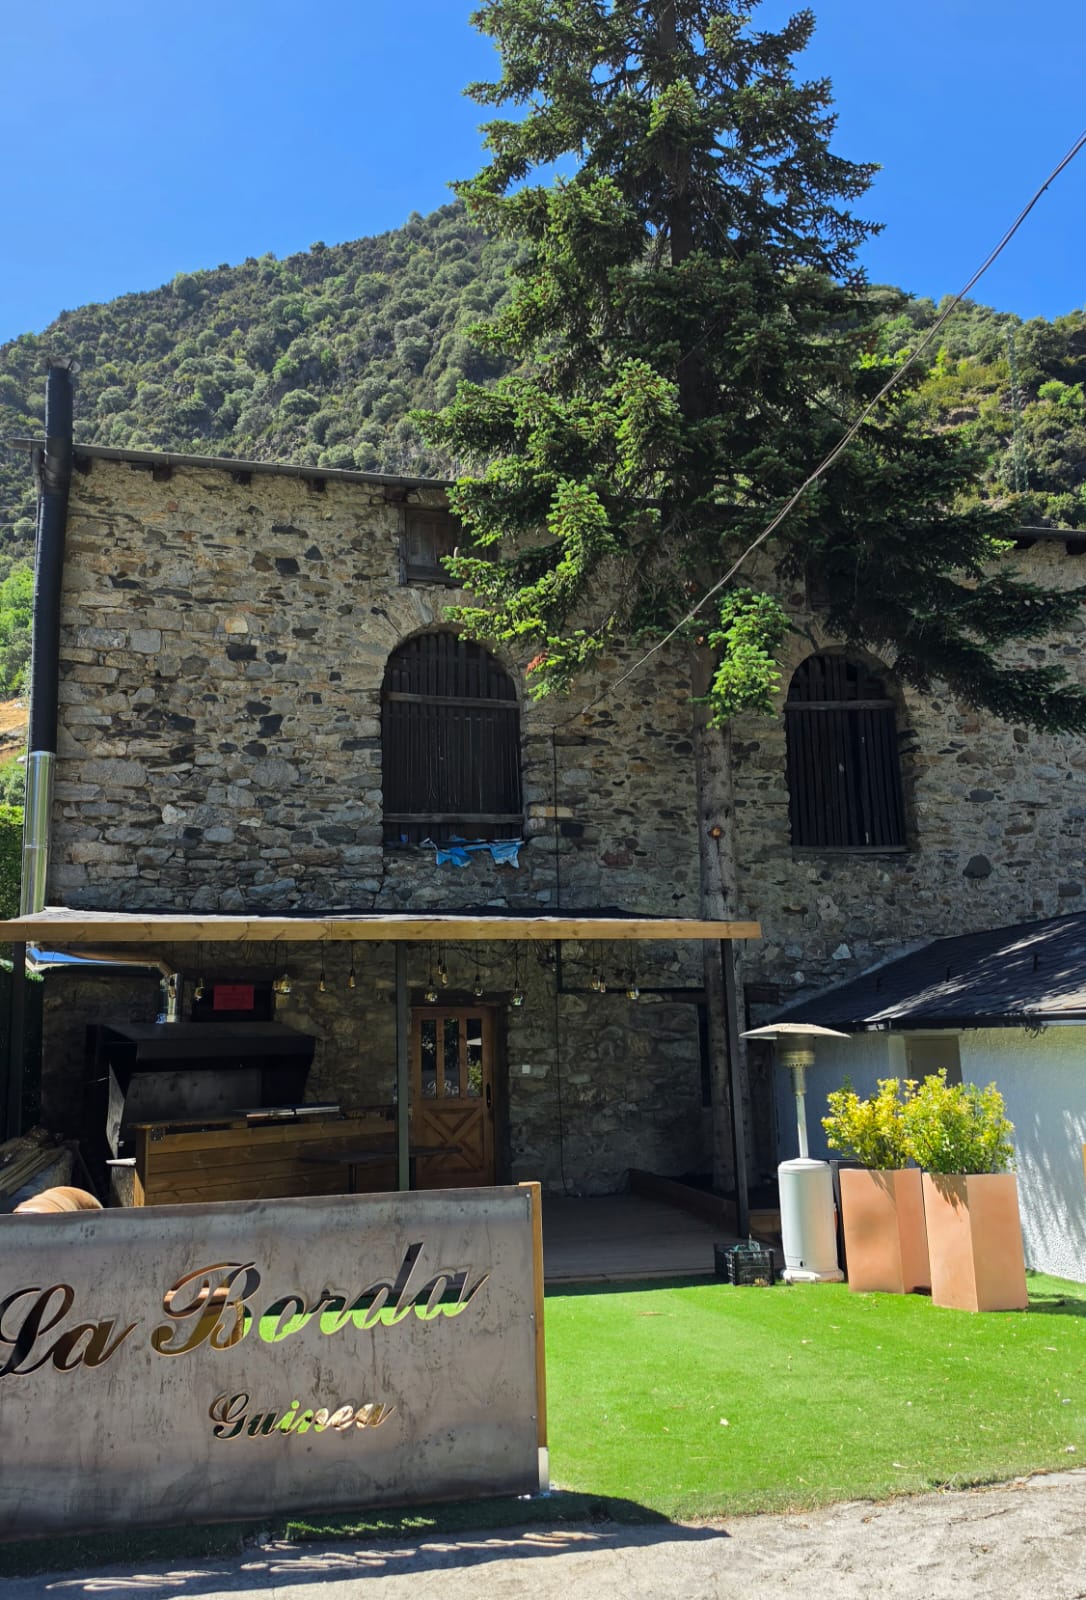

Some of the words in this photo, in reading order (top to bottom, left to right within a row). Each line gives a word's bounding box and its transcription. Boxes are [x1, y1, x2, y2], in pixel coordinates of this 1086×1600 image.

[0, 1284, 138, 1377] La
[150, 1242, 490, 1357] Borda
[209, 1392, 397, 1440] Guinea
